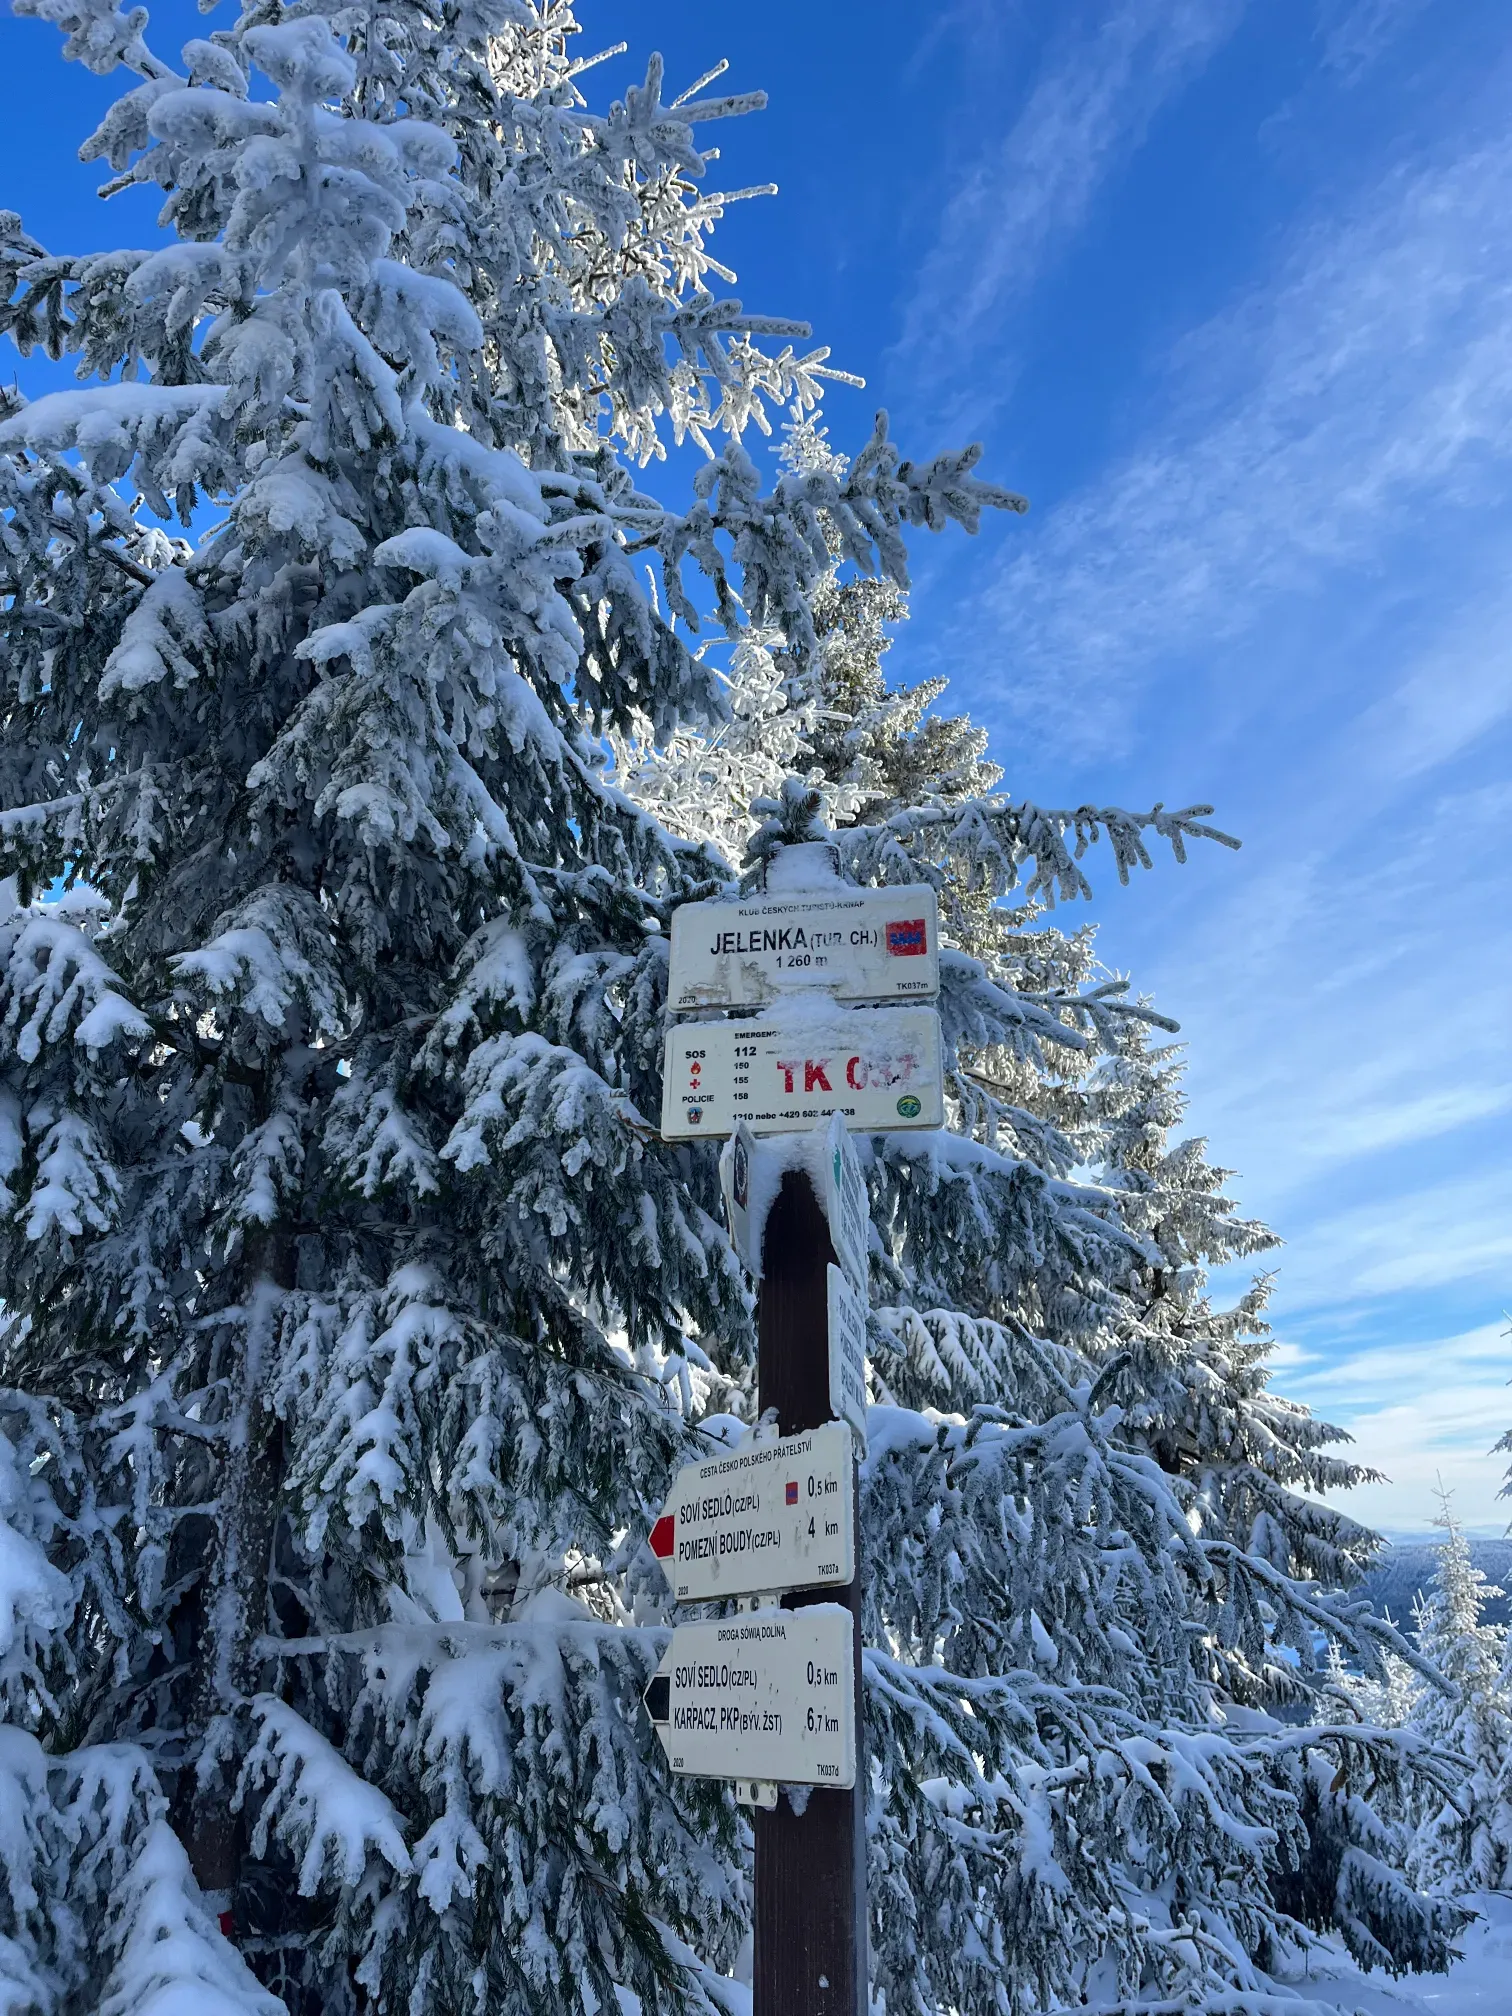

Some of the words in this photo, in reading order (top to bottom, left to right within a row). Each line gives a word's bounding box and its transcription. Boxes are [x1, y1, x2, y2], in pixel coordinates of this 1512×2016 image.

[739, 909, 759, 917] KLUB
[762, 905, 799, 914] ČESKÝCH
[711, 928, 808, 955] JELENKA
[850, 931, 878, 948] CH.)
[776, 956, 782, 968] 1
[788, 954, 811, 968] 260
[896, 982, 928, 990] TK037m
[735, 1031, 781, 1039] EMERGENC
[685, 1050, 706, 1059] SOS
[734, 1046, 757, 1057] 112
[734, 1062, 749, 1070] 150
[777, 1058, 832, 1093] TK
[682, 1095, 715, 1103] POLICIE
[755, 1112, 777, 1120] nebo
[700, 1464, 718, 1479] CESTA
[719, 1459, 738, 1475] ČESKO
[739, 1450, 772, 1469] POLSKÉHO
[680, 1496, 701, 1525] SOVÍ
[808, 1475, 822, 1499] 0,5
[824, 1479, 838, 1495] km
[679, 1530, 718, 1562] POMEZNÍ
[808, 1516, 815, 1538] 4
[825, 1521, 839, 1536] km
[818, 1563, 839, 1576] TK037a
[718, 1629, 739, 1641] DROGA
[675, 1661, 697, 1688] SOVÍ
[807, 1660, 822, 1688] 0,5
[824, 1668, 838, 1685] km
[674, 1706, 718, 1734] KARPACZ,
[763, 1710, 782, 1735] ŽST)
[807, 1706, 823, 1735] 6,7
[825, 1715, 839, 1732] km
[673, 1757, 684, 1767] 2020
[817, 1764, 840, 1777] TK037d
